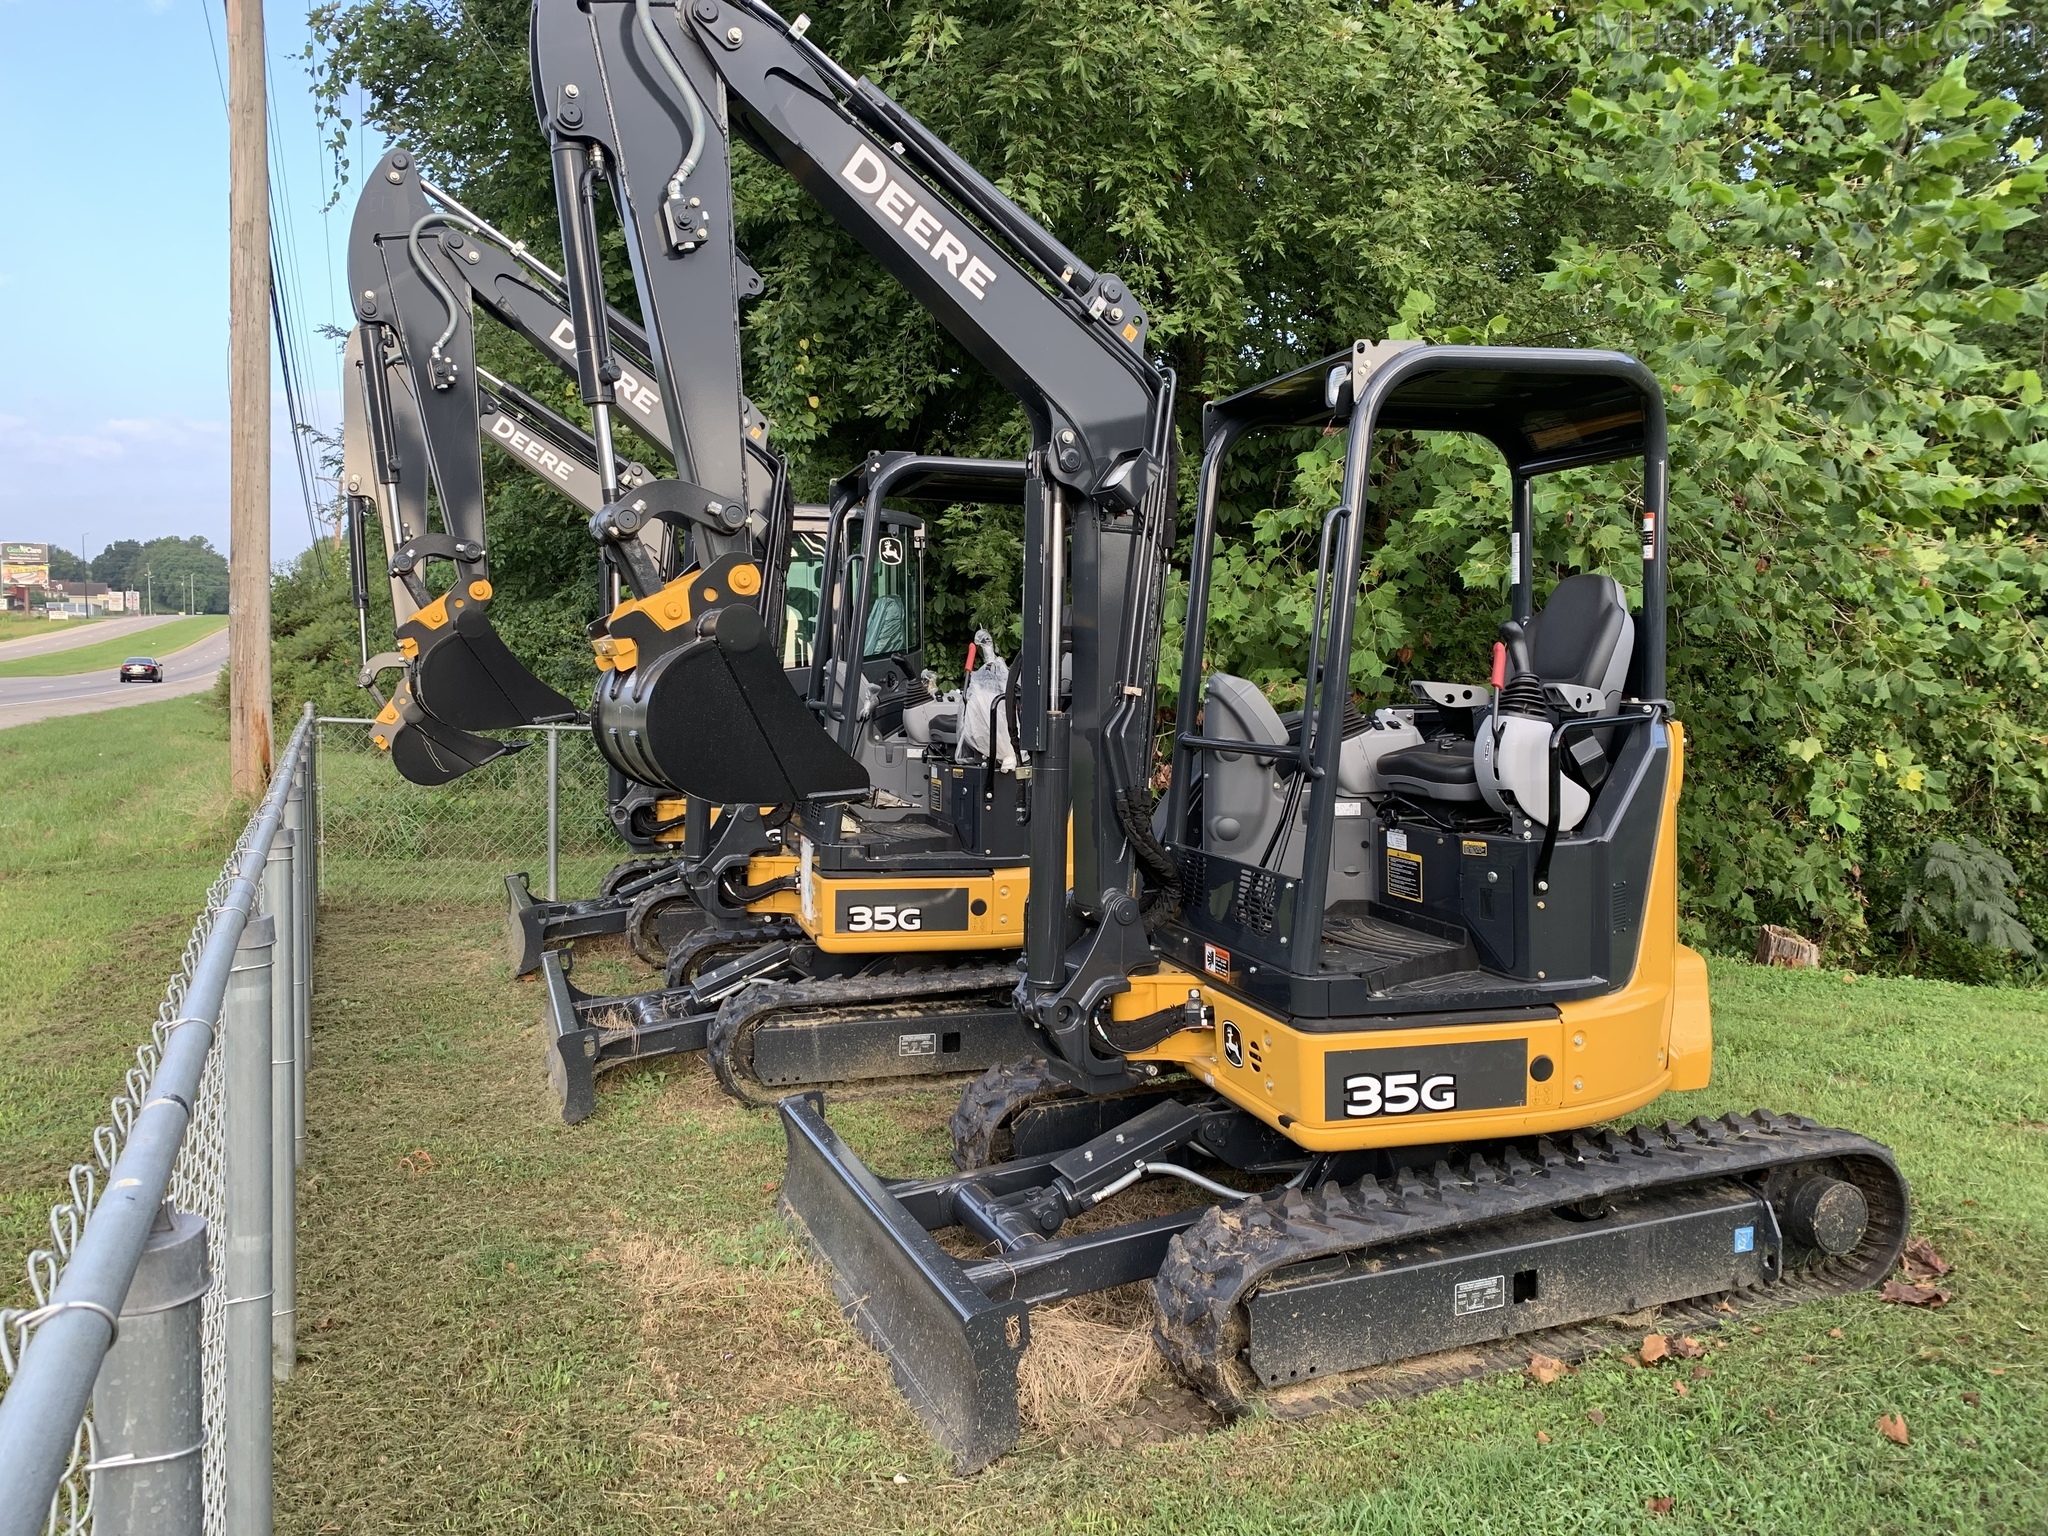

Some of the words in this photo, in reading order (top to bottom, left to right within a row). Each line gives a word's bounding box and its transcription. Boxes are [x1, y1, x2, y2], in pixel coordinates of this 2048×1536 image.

[841, 143, 997, 301] DEERE
[549, 318, 660, 415] DRE
[491, 416, 575, 481] DEERE
[849, 905, 921, 931] 35G
[1346, 1074, 1455, 1116] 35G
